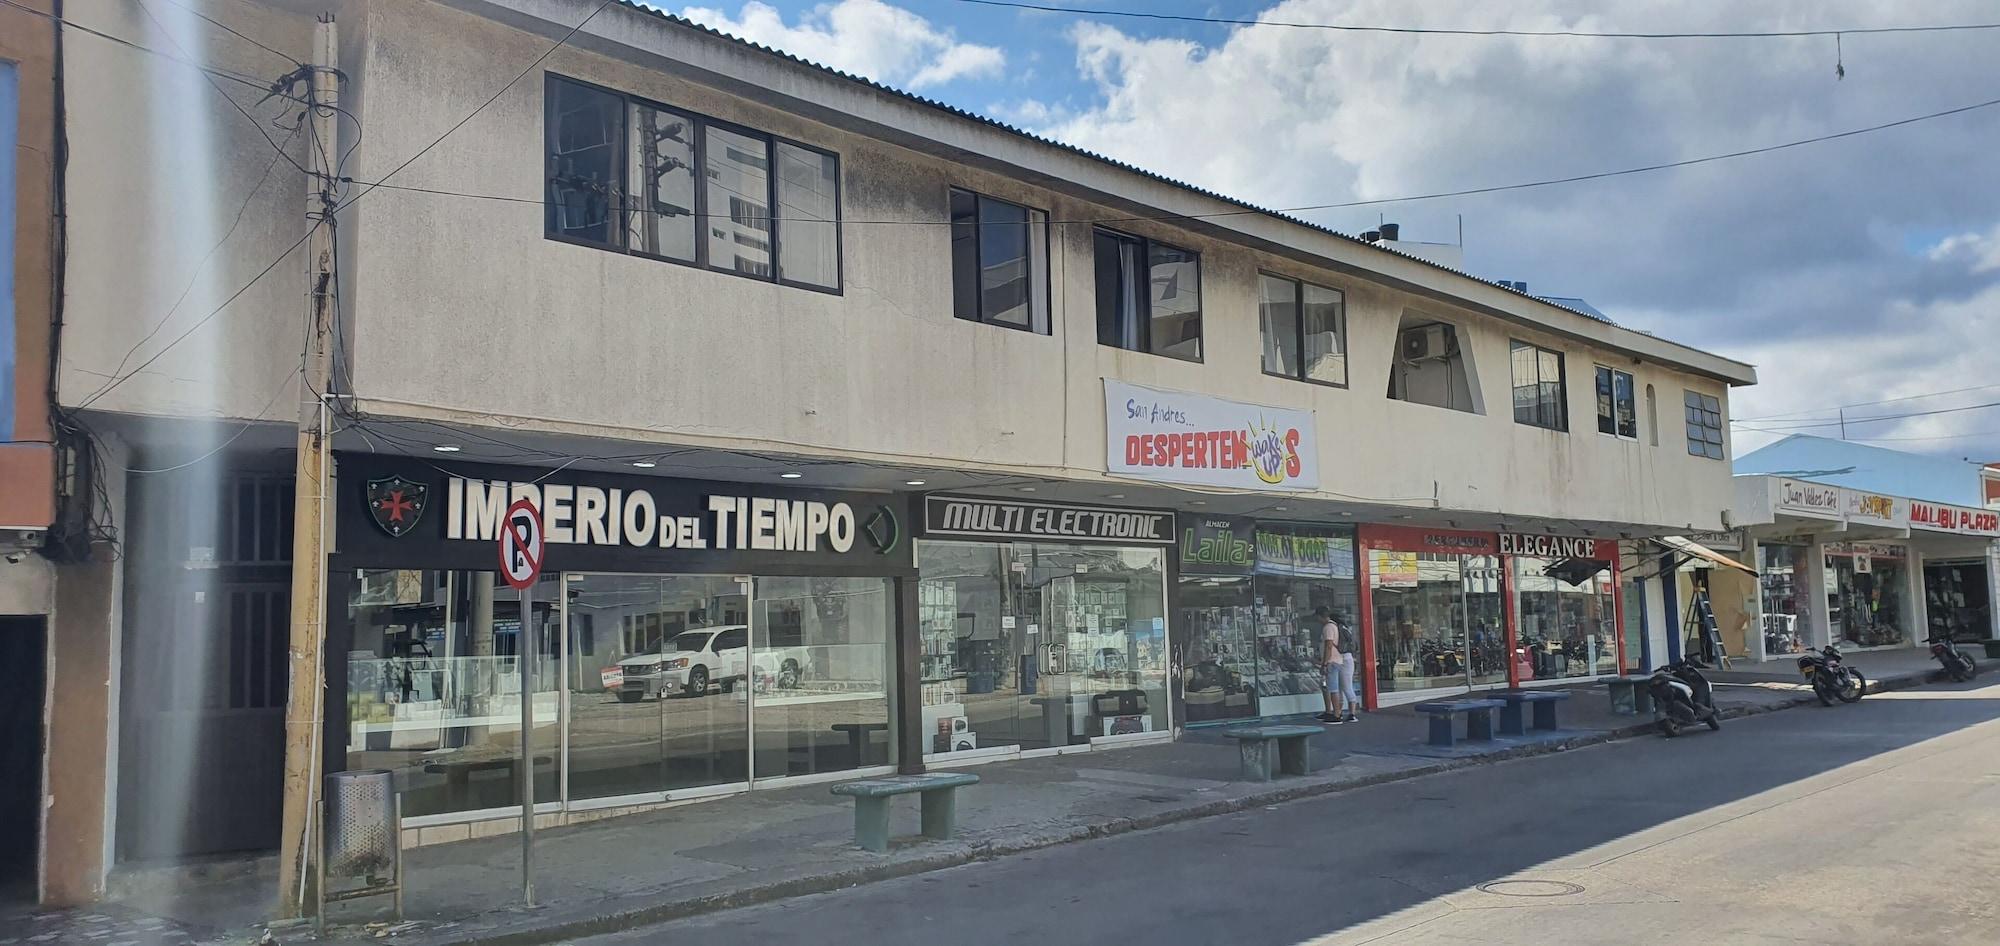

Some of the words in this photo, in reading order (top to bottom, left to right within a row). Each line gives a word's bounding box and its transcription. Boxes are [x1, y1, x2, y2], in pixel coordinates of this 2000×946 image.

[1126, 398, 1147, 419] San
[1783, 482, 1802, 504] Juan
[659, 515, 707, 549] DEL
[708, 494, 856, 553] TIEMPO
[942, 502, 1025, 532] MULTI
[1029, 508, 1163, 539] ELECTRONIC
[1205, 518, 1231, 528] ALMACEN
[1911, 503, 1957, 529] MALIBU
[1960, 511, 1997, 531] PLAZA
[1182, 527, 1248, 565] Laila
[1498, 532, 1596, 558] ELEGANCE
